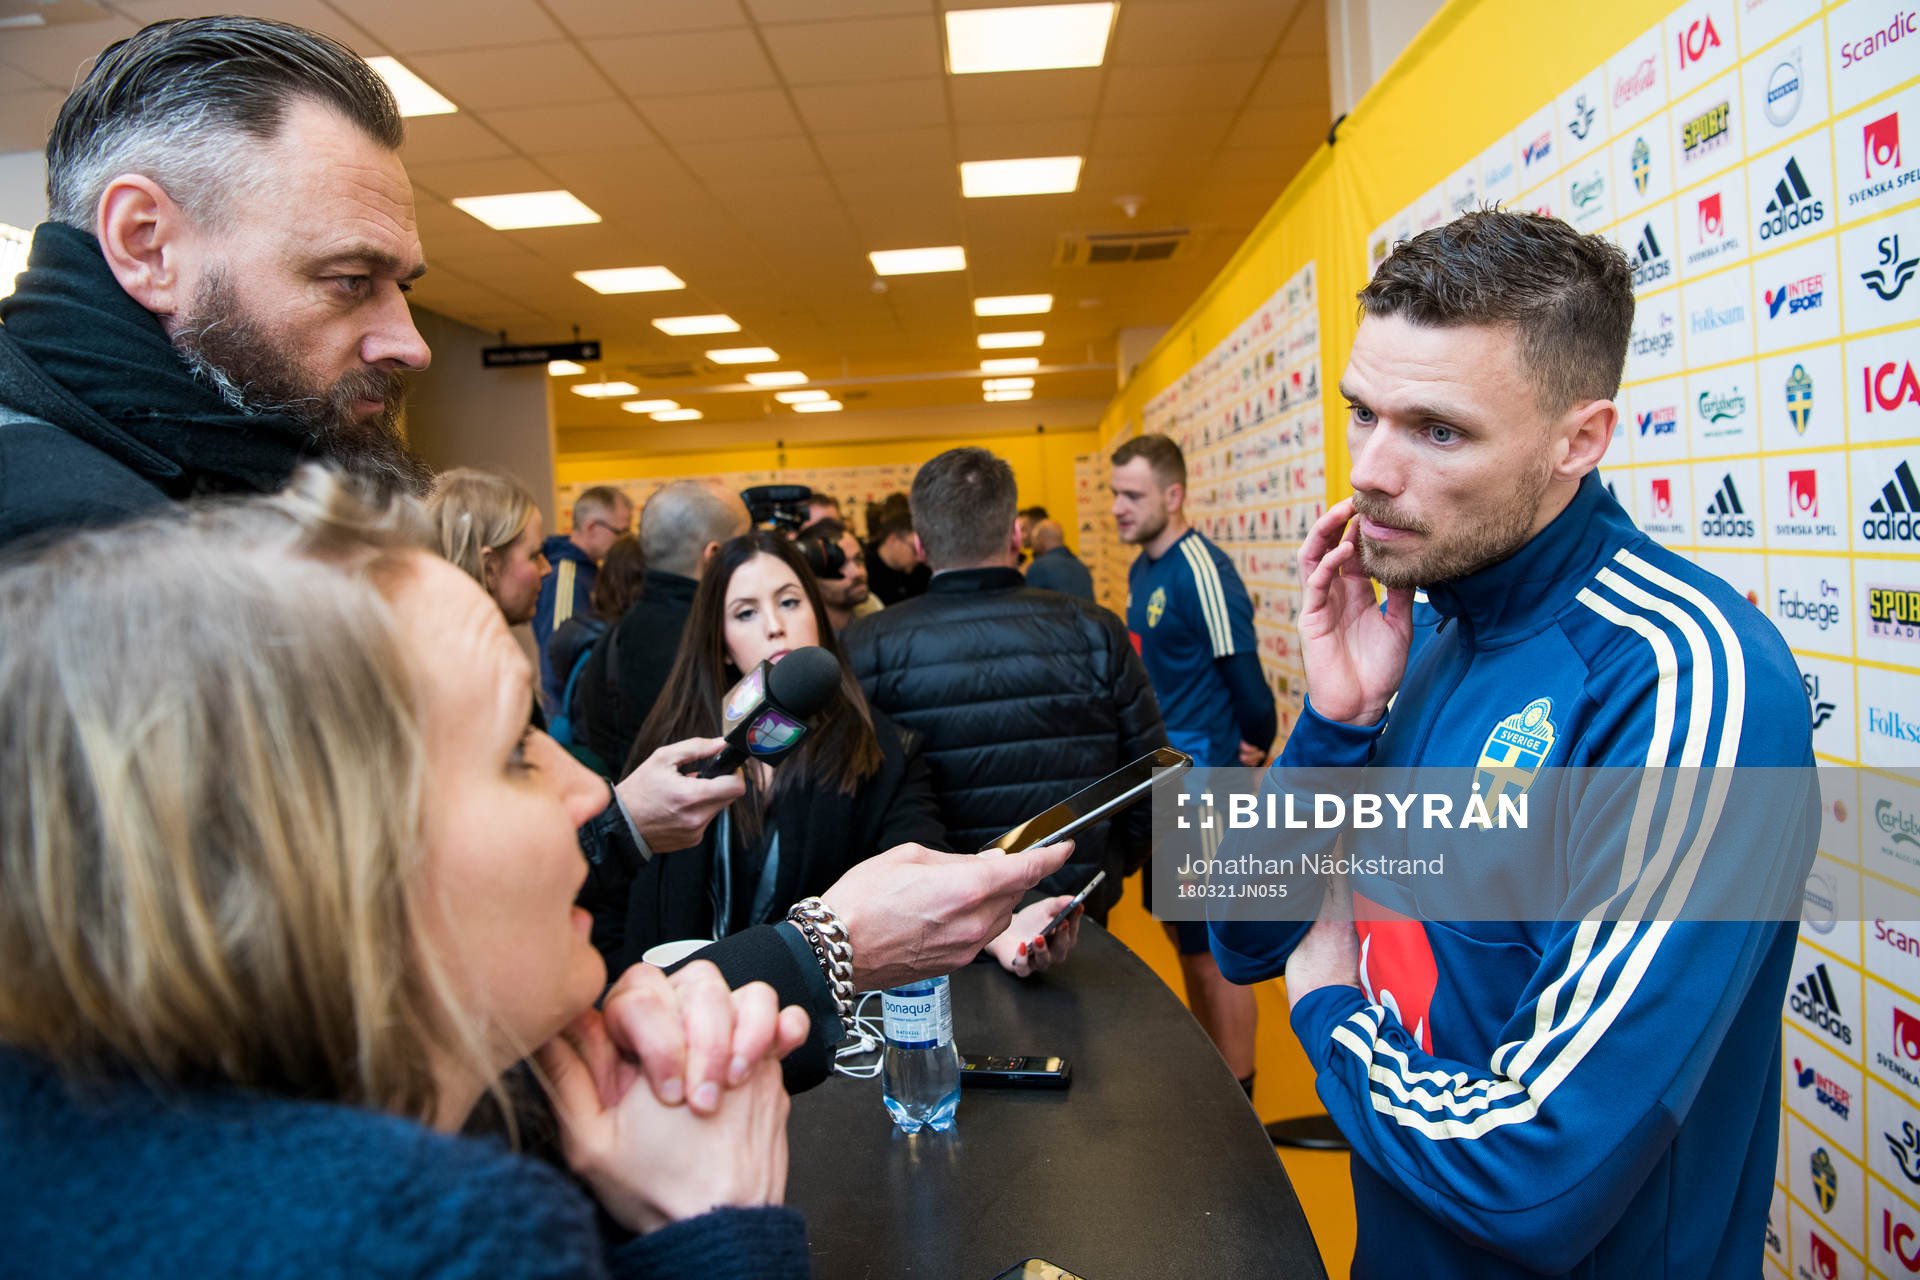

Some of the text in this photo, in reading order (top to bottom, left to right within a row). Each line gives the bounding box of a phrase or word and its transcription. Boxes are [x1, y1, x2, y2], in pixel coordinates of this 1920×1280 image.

[1678, 14, 1721, 70] ICA
[1841, 10, 1917, 69] Scandic
[1683, 101, 1729, 151] SPORT
[1849, 179, 1894, 206] SVENSKA
[1759, 201, 1824, 240] adidas
[1878, 234, 1899, 265] SJ
[1788, 274, 1823, 298] INTER
[1789, 292, 1824, 314] SPORT
[1702, 514, 1754, 537] adidas
[1778, 589, 1840, 630] Fabege
[1873, 624, 1920, 639] BLAD
[1500, 730, 1541, 750] SVERIGE
[1790, 994, 1852, 1046] adidas
[1815, 1072, 1851, 1106] INTER
